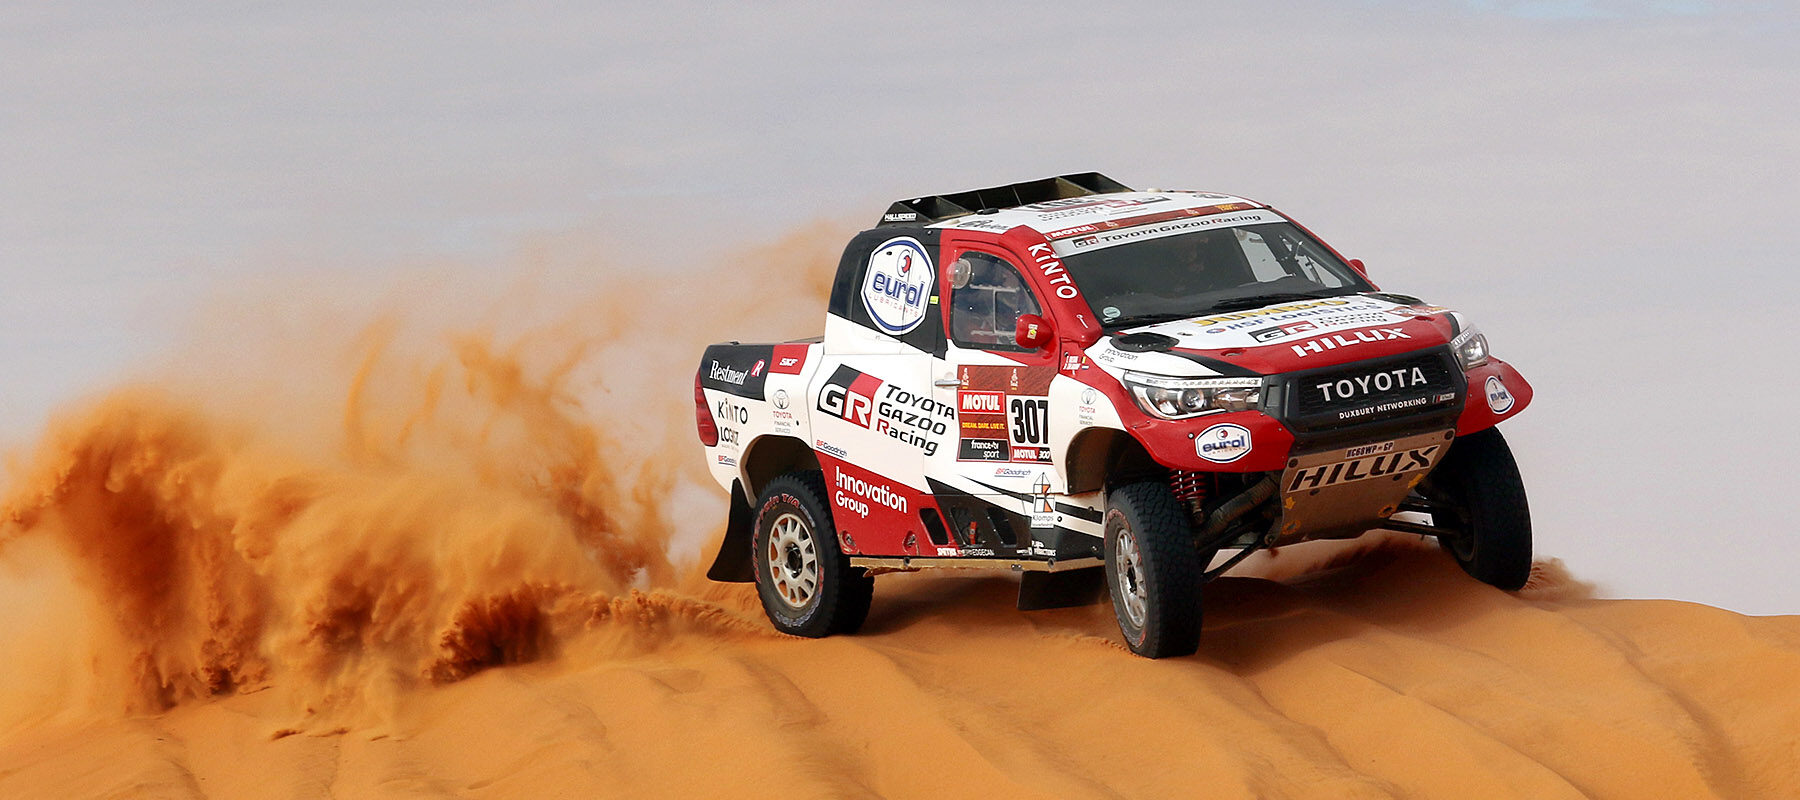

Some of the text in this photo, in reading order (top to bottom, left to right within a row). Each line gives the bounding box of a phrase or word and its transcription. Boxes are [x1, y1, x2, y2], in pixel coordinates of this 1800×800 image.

[1051, 224, 1094, 237] MOTUL
[1101, 228, 1158, 242] TOYOTA
[1159, 220, 1210, 232] GAZOO
[1211, 214, 1262, 225] Racing
[872, 272, 925, 308] eurol
[1255, 322, 1318, 342] GR
[1291, 328, 1411, 357] HILUX
[779, 358, 798, 367] SKF
[1316, 367, 1428, 401] TOYOTA
[819, 383, 872, 429] GR
[886, 384, 955, 421] TOYOTA
[963, 394, 1000, 411] MOTUL
[1339, 398, 1427, 419] DUXBURY NETWORKING
[879, 402, 947, 436] GAZOO
[1011, 399, 1048, 444] 307
[876, 418, 938, 457] Racing
[1202, 435, 1246, 453] eurol
[983, 450, 1000, 461] sport
[1013, 448, 1037, 459] MOTUL
[1289, 445, 1439, 491] HILUX
[835, 490, 869, 519] Group
